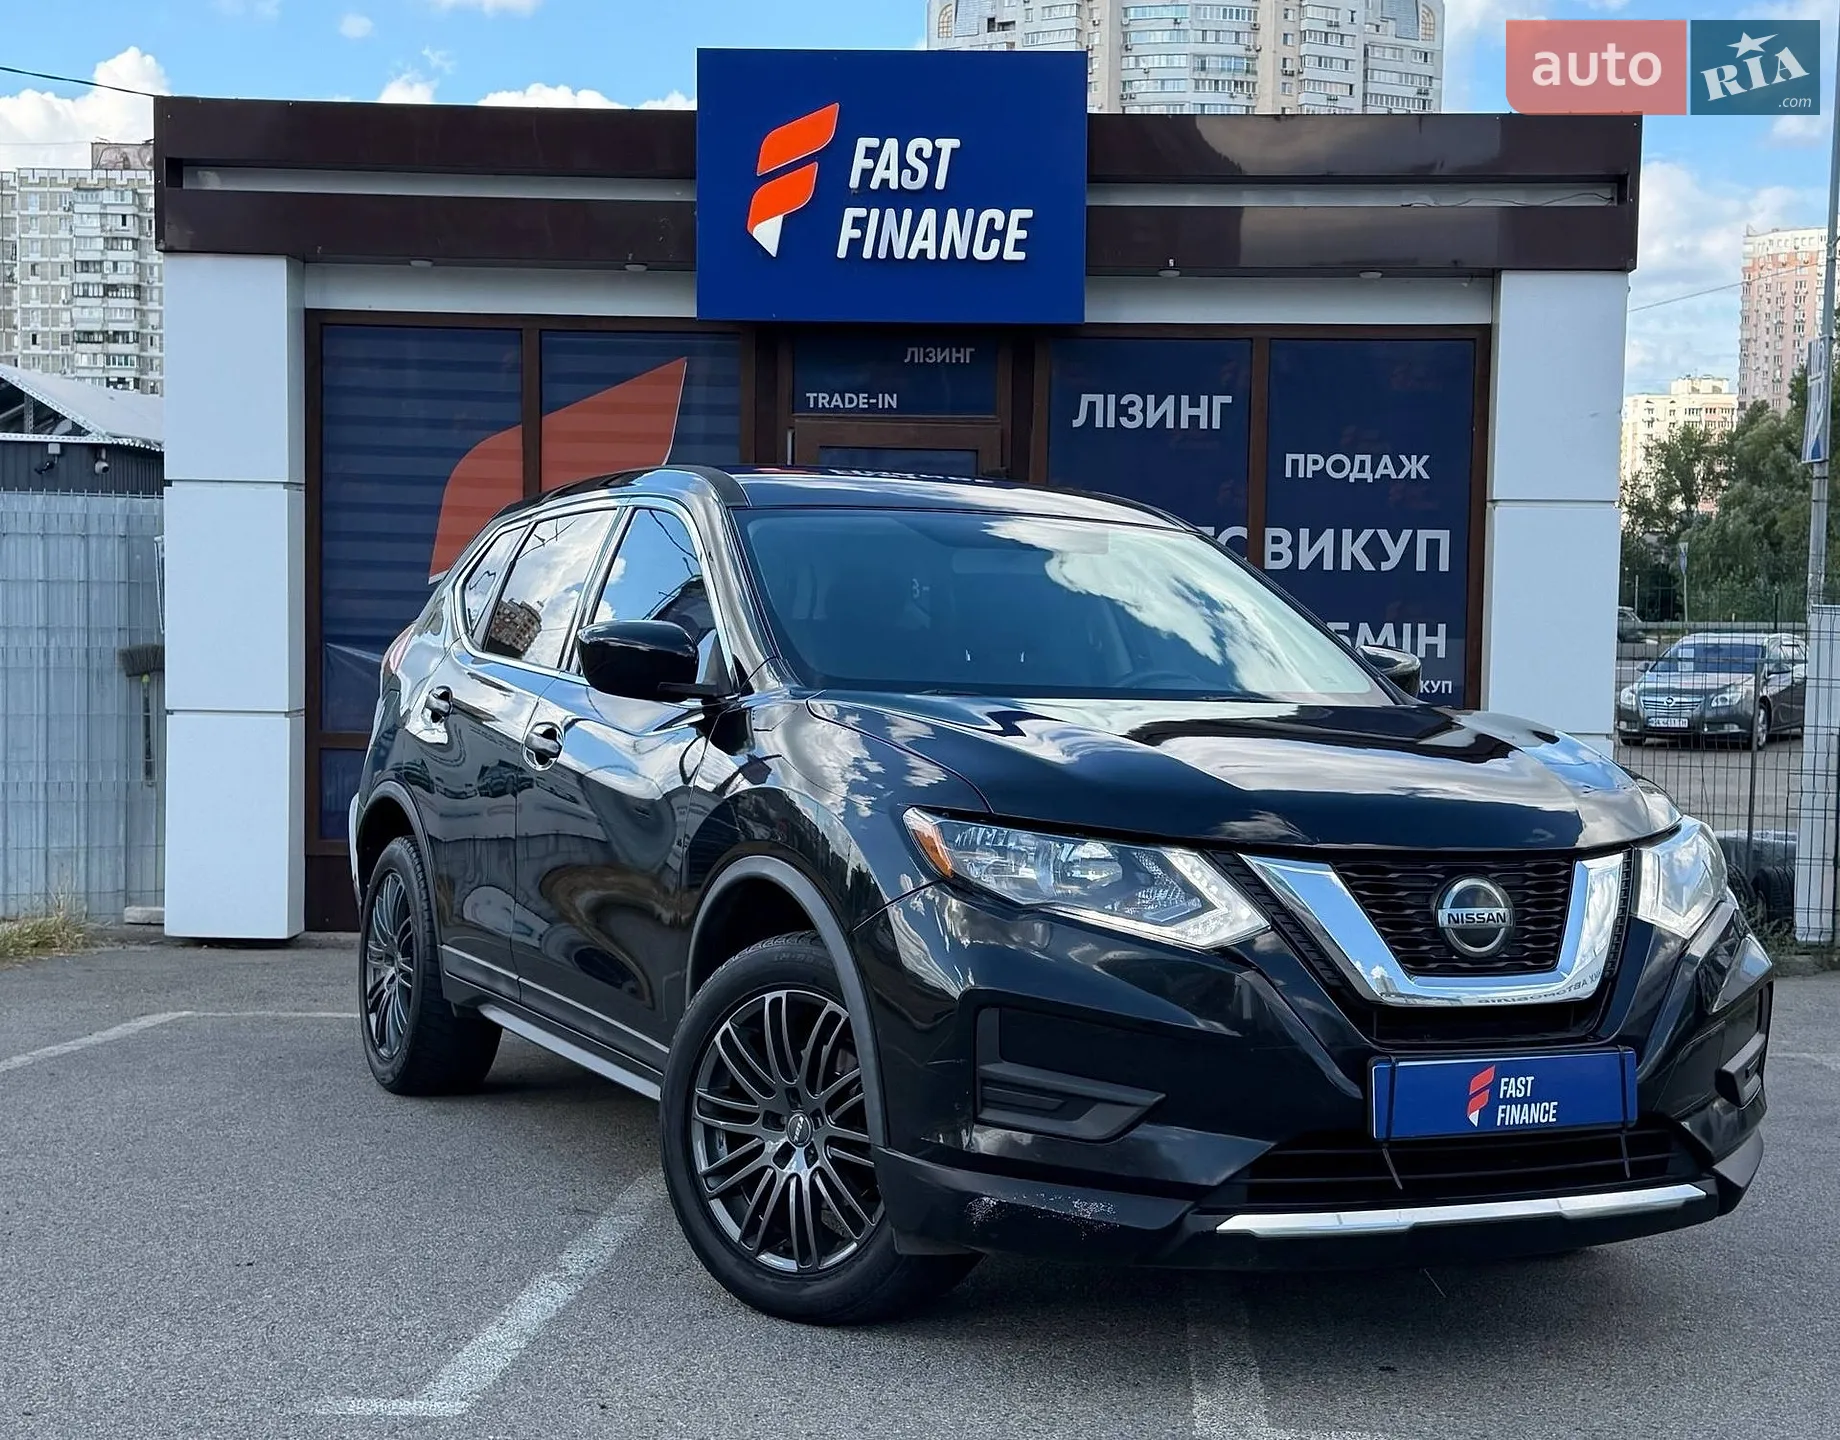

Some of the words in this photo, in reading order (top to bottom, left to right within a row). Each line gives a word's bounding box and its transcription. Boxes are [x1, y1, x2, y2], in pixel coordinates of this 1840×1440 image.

[848, 137, 961, 190] FAST
[836, 207, 1034, 261] FINANCE
[904, 347, 975, 364] ЛІЗИНГ
[806, 392, 898, 409] TRADE-IN
[1072, 393, 1233, 430] ЛІЗИНГ
[1284, 453, 1431, 483] ПРОДАЖ
[1196, 526, 1451, 572] ВИКУП
[1447, 912, 1507, 925] NISSAN
[1499, 1075, 1535, 1099] FAST
[1496, 1101, 1558, 1127] FINANCE
